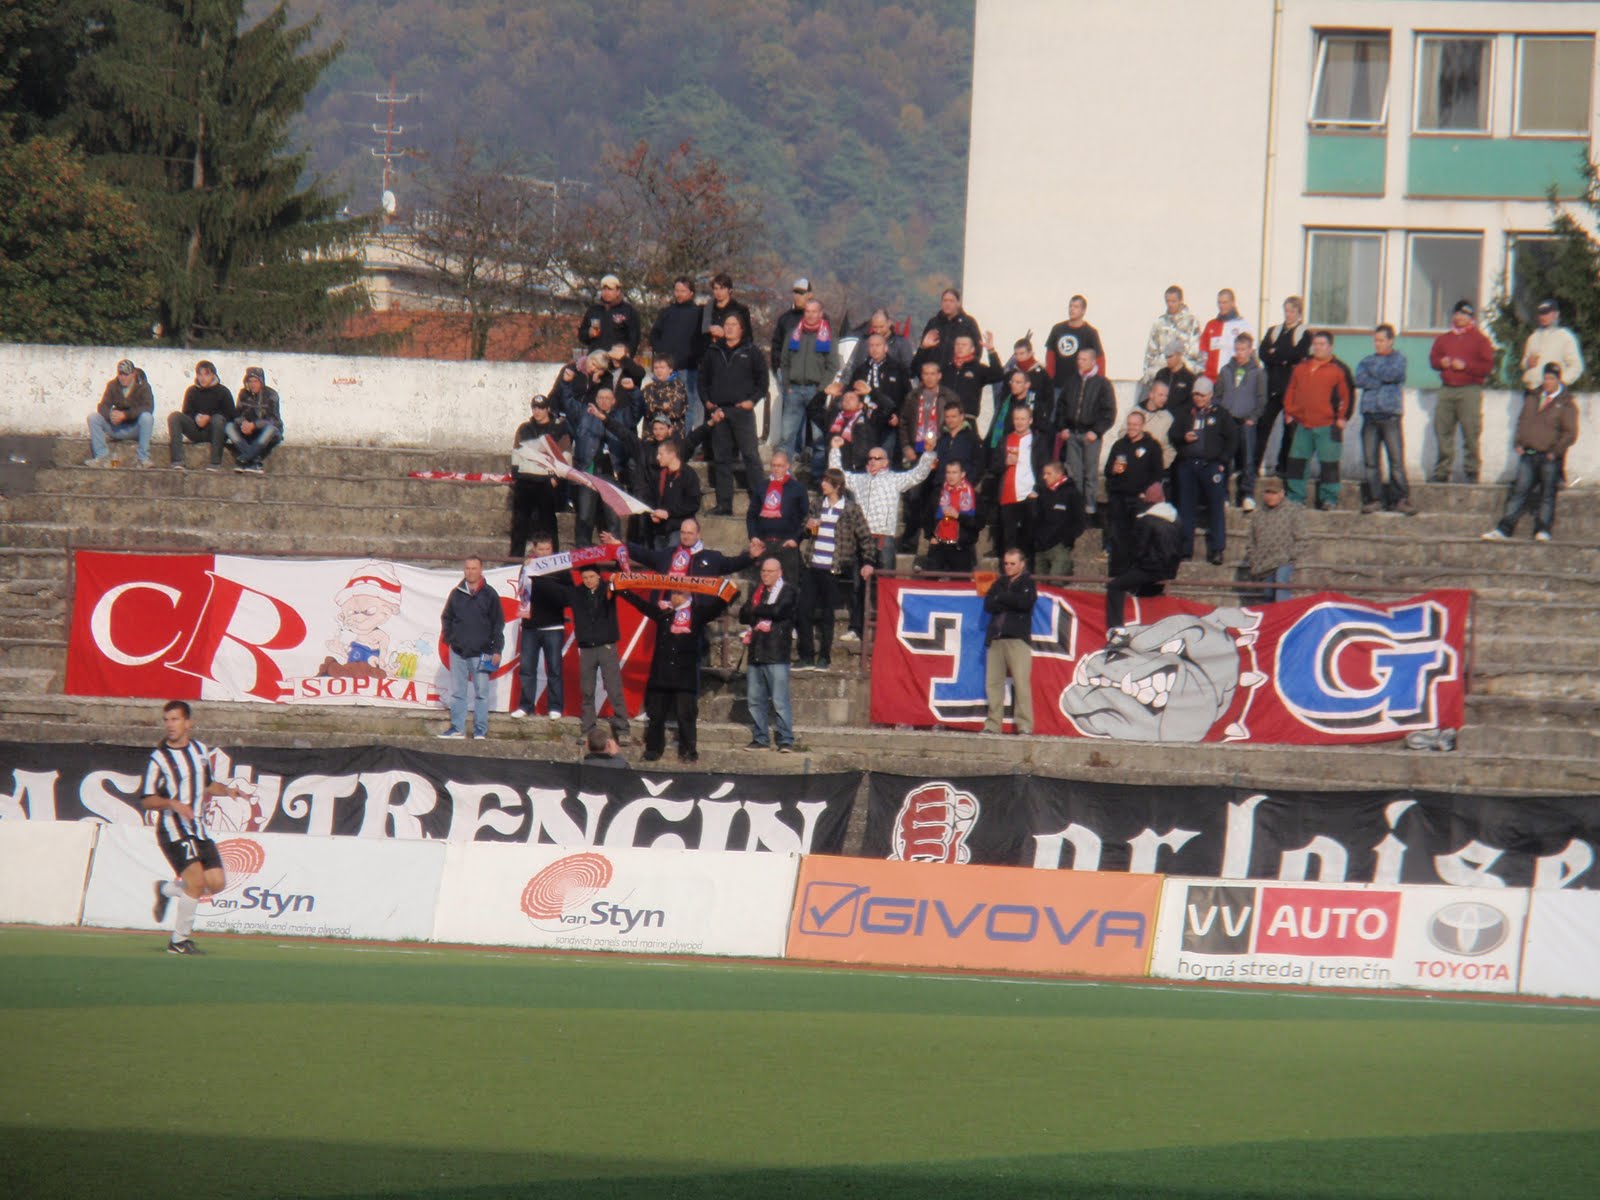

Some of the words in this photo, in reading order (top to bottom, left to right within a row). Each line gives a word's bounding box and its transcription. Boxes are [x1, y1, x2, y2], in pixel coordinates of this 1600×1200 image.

[1274, 600, 1459, 735] G
[301, 676, 420, 703] SOPKA
[181, 840, 199, 861] 21
[210, 898, 238, 910] van
[240, 886, 315, 918] Styn
[206, 919, 243, 931] sandwich
[244, 922, 270, 934] panels
[271, 924, 288, 932] and
[289, 925, 317, 934] marine
[317, 924, 351, 937] plywood
[559, 913, 587, 924] van
[590, 901, 665, 934] Styn
[860, 896, 1147, 949] GIVOVA
[1187, 904, 1252, 937] VV
[1267, 904, 1389, 941] AUTO
[556, 935, 592, 946] sandwich
[594, 937, 620, 949] panels
[622, 938, 638, 948] and
[640, 940, 669, 949] marine
[670, 940, 703, 952] plywood
[1177, 957, 1235, 978] horná
[1240, 961, 1303, 979] streda
[1318, 963, 1392, 982] trenčín
[1415, 960, 1511, 982] TOYOTA
